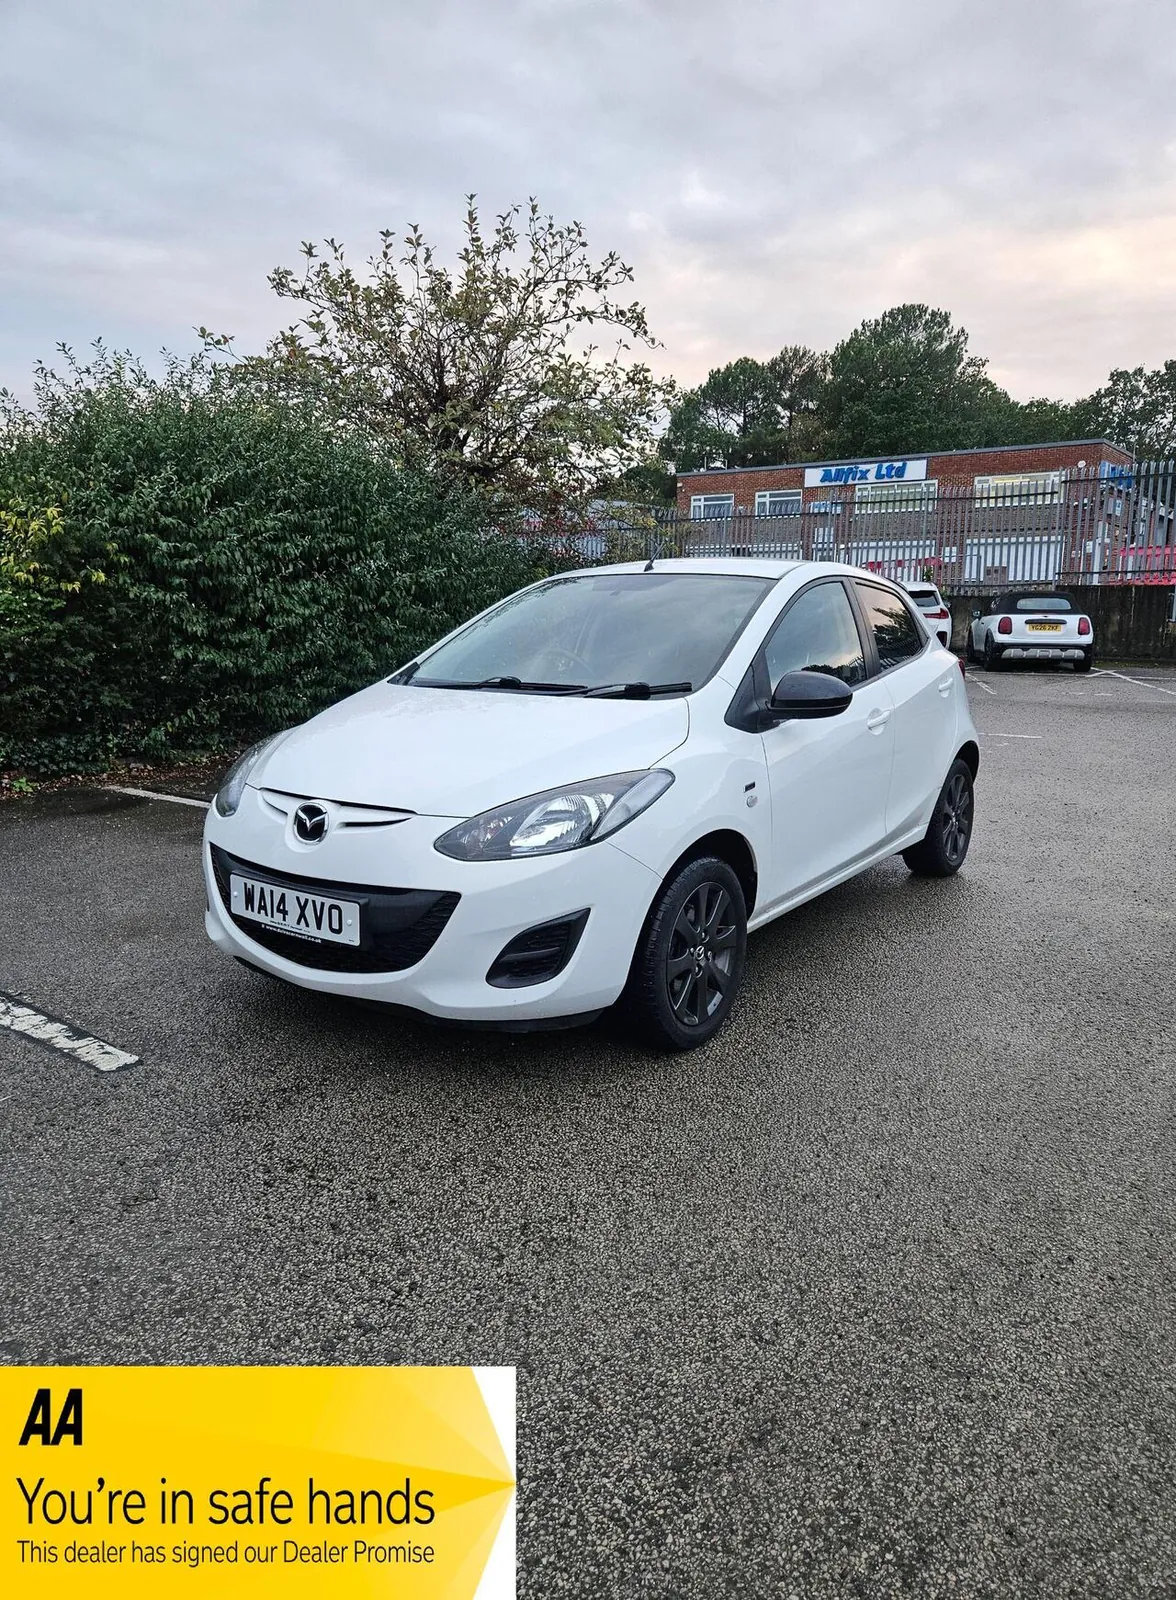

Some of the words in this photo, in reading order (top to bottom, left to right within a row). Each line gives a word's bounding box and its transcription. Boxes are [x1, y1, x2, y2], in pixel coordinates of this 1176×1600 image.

[820, 465, 871, 485] Allfix
[874, 461, 908, 480] Ltd
[244, 882, 288, 922] WA14
[296, 895, 343, 935] XVO
